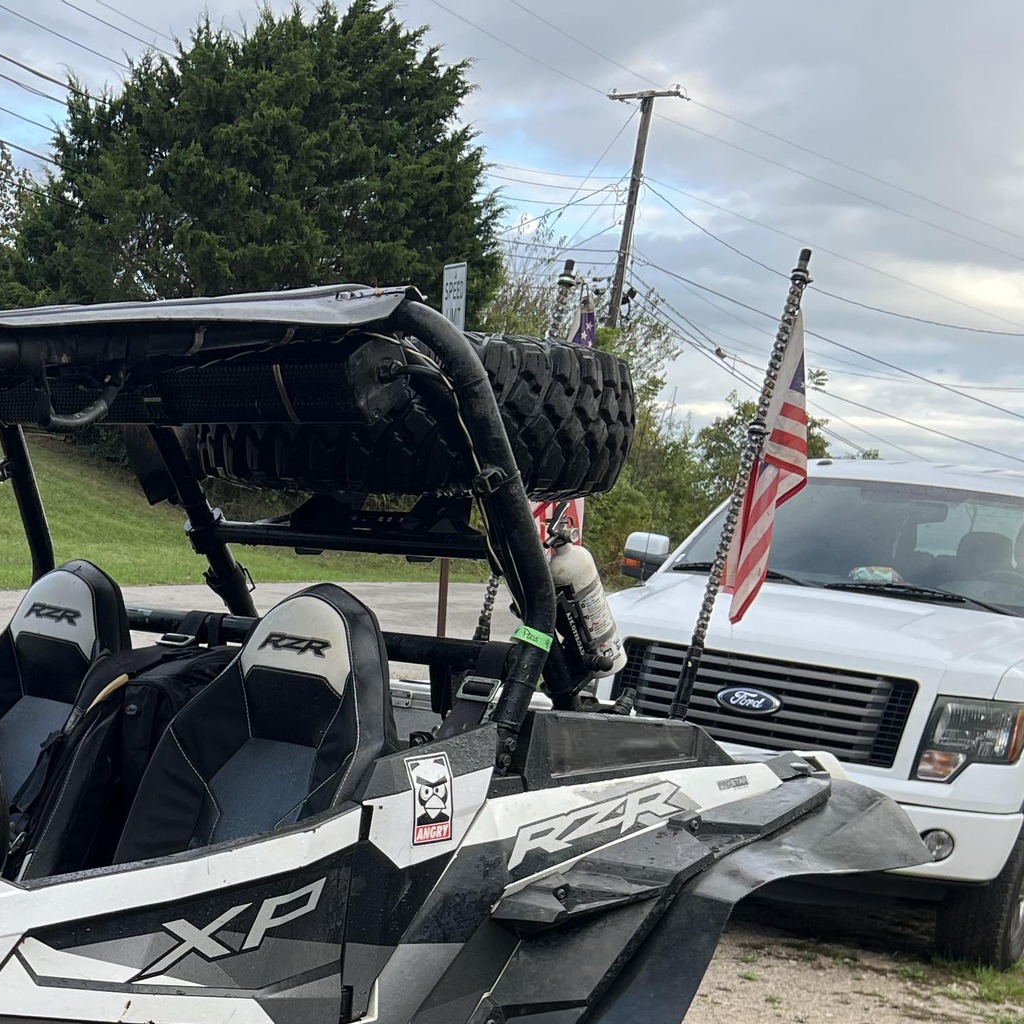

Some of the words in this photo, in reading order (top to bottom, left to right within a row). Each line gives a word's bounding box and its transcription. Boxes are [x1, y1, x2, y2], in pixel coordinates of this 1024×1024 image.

[444, 280, 464, 301] SPEED
[24, 602, 83, 627] RZR
[257, 631, 333, 659] RZR
[729, 690, 766, 709] Ford
[416, 822, 452, 842] ANGRY
[507, 780, 681, 871] RZR
[134, 877, 327, 980] XP
